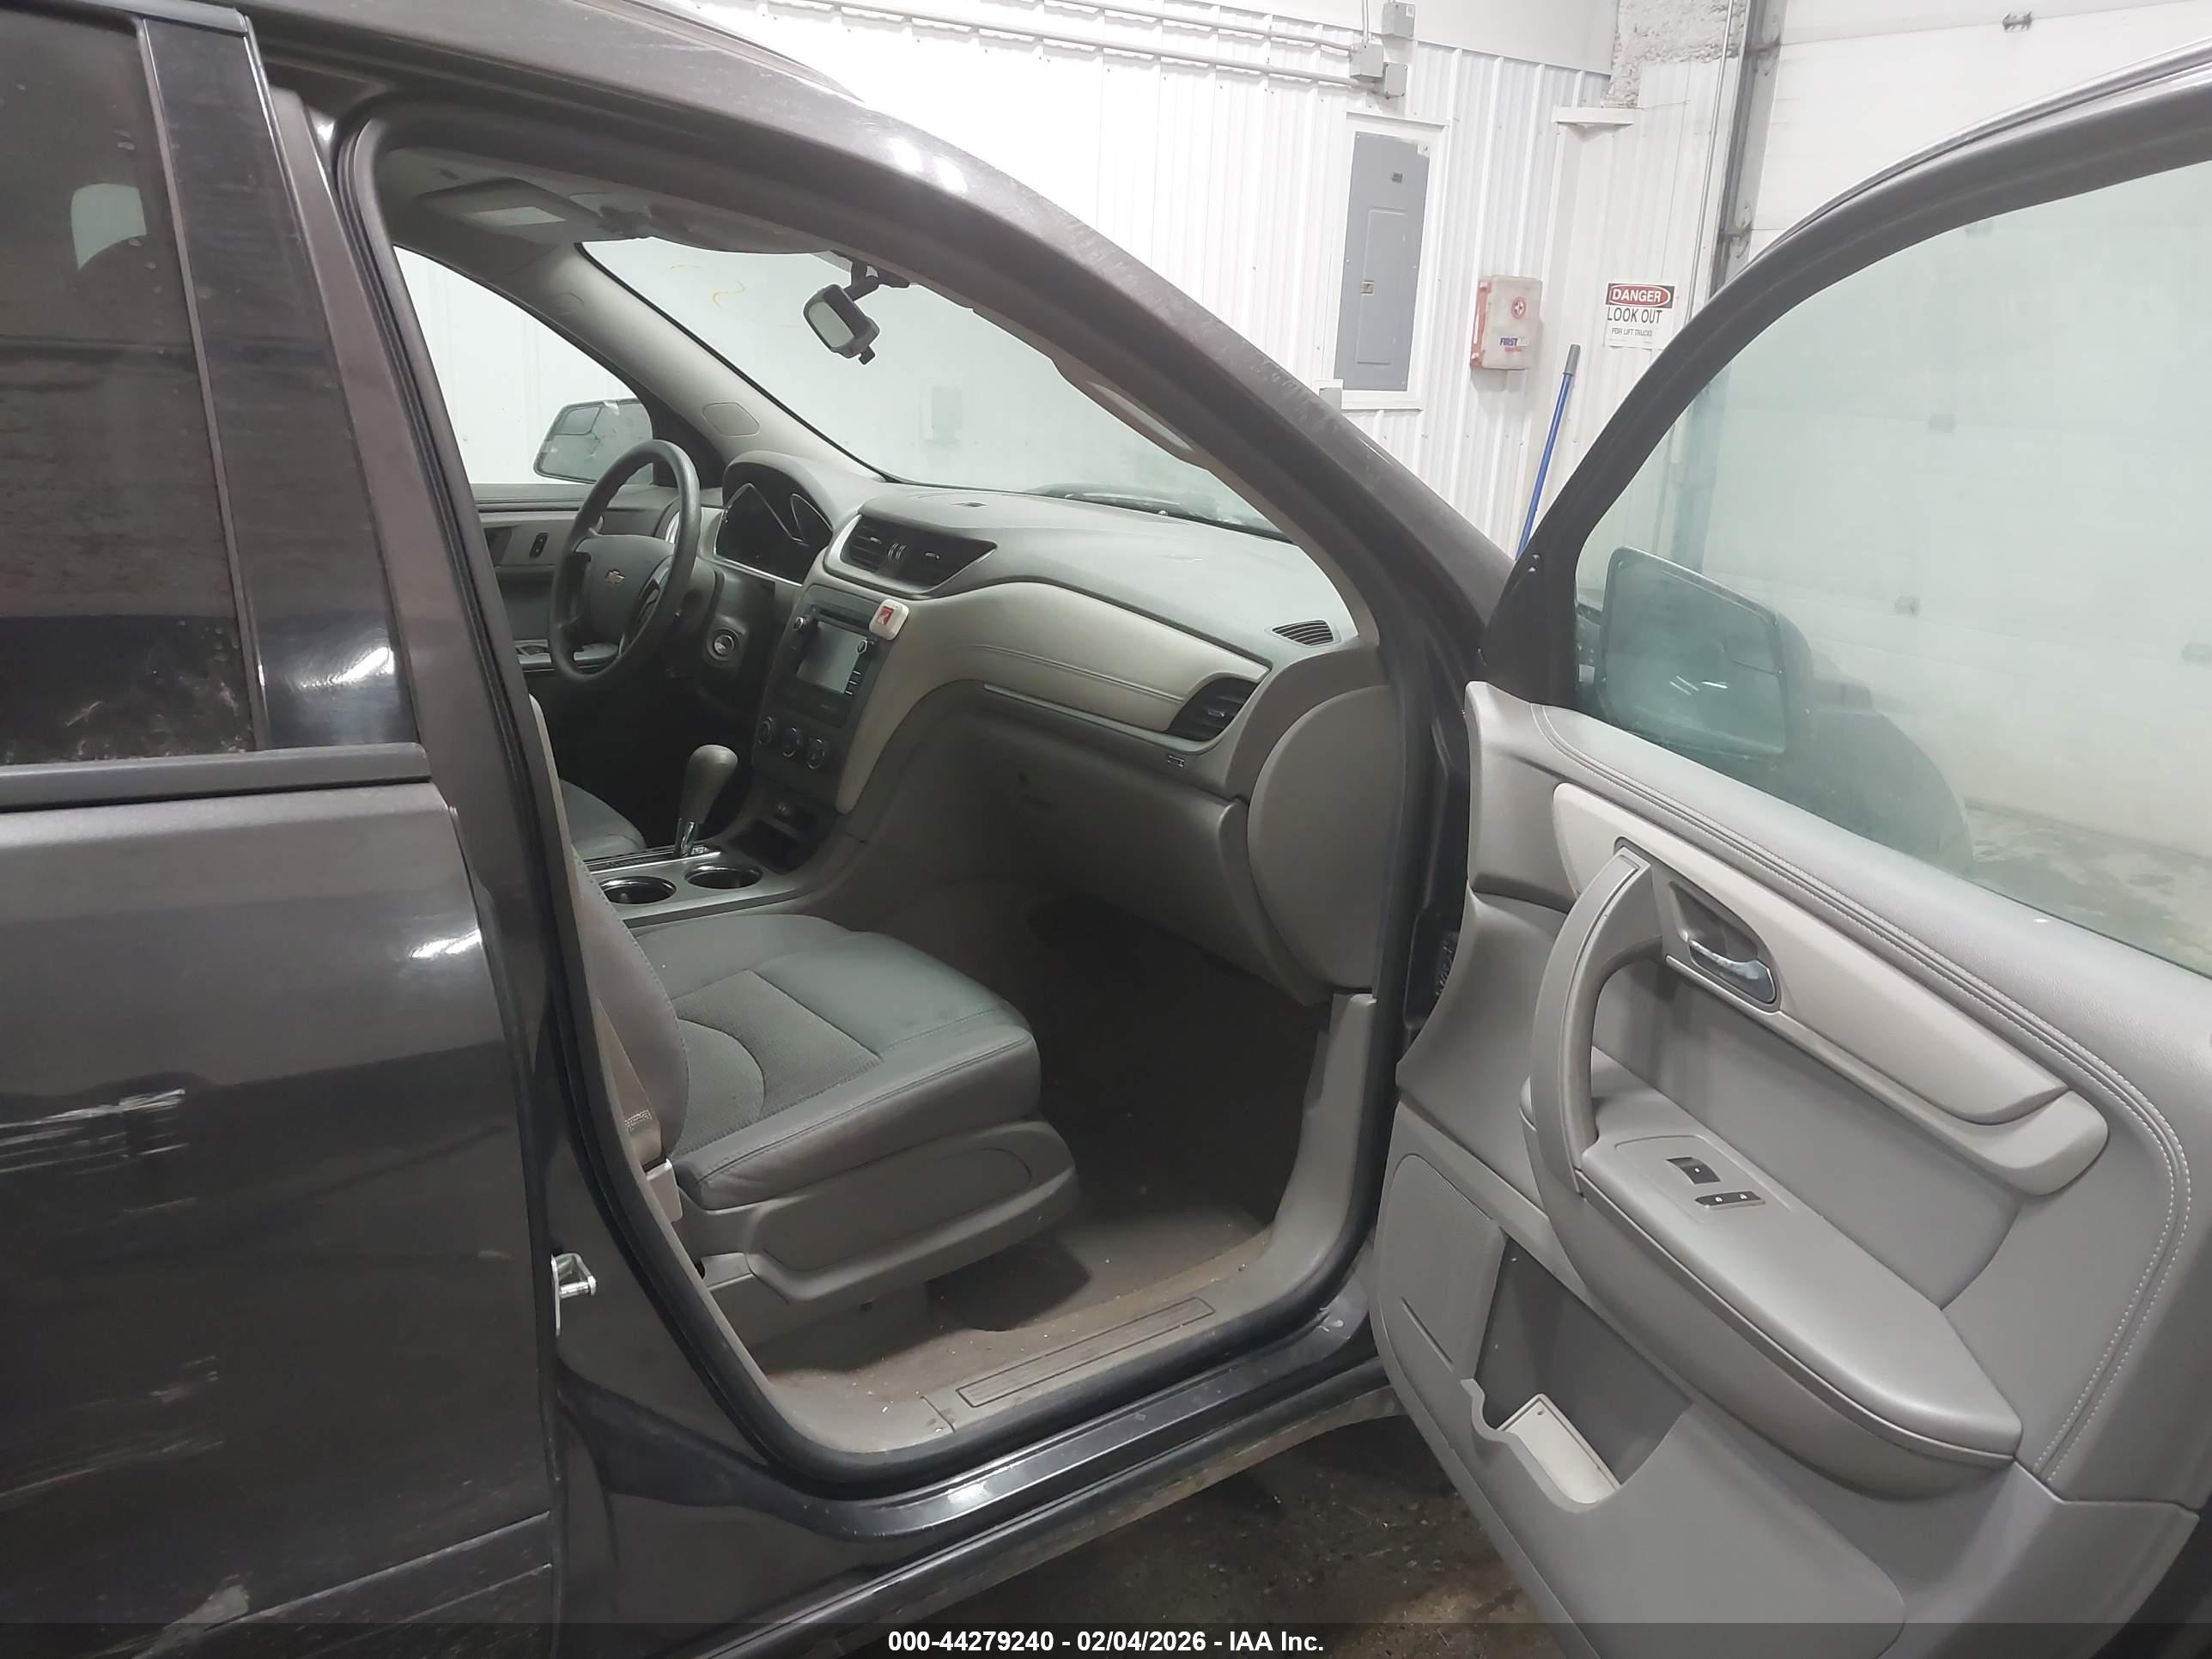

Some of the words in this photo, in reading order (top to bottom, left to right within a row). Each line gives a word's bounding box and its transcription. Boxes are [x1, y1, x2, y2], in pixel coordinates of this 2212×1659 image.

[1612, 289, 1662, 303] DANGER
[1607, 307, 1638, 323] LOOK
[1641, 308, 1662, 324] OUT
[1634, 329, 1653, 337] TRUCKS
[1499, 337, 1518, 346] FIRST
